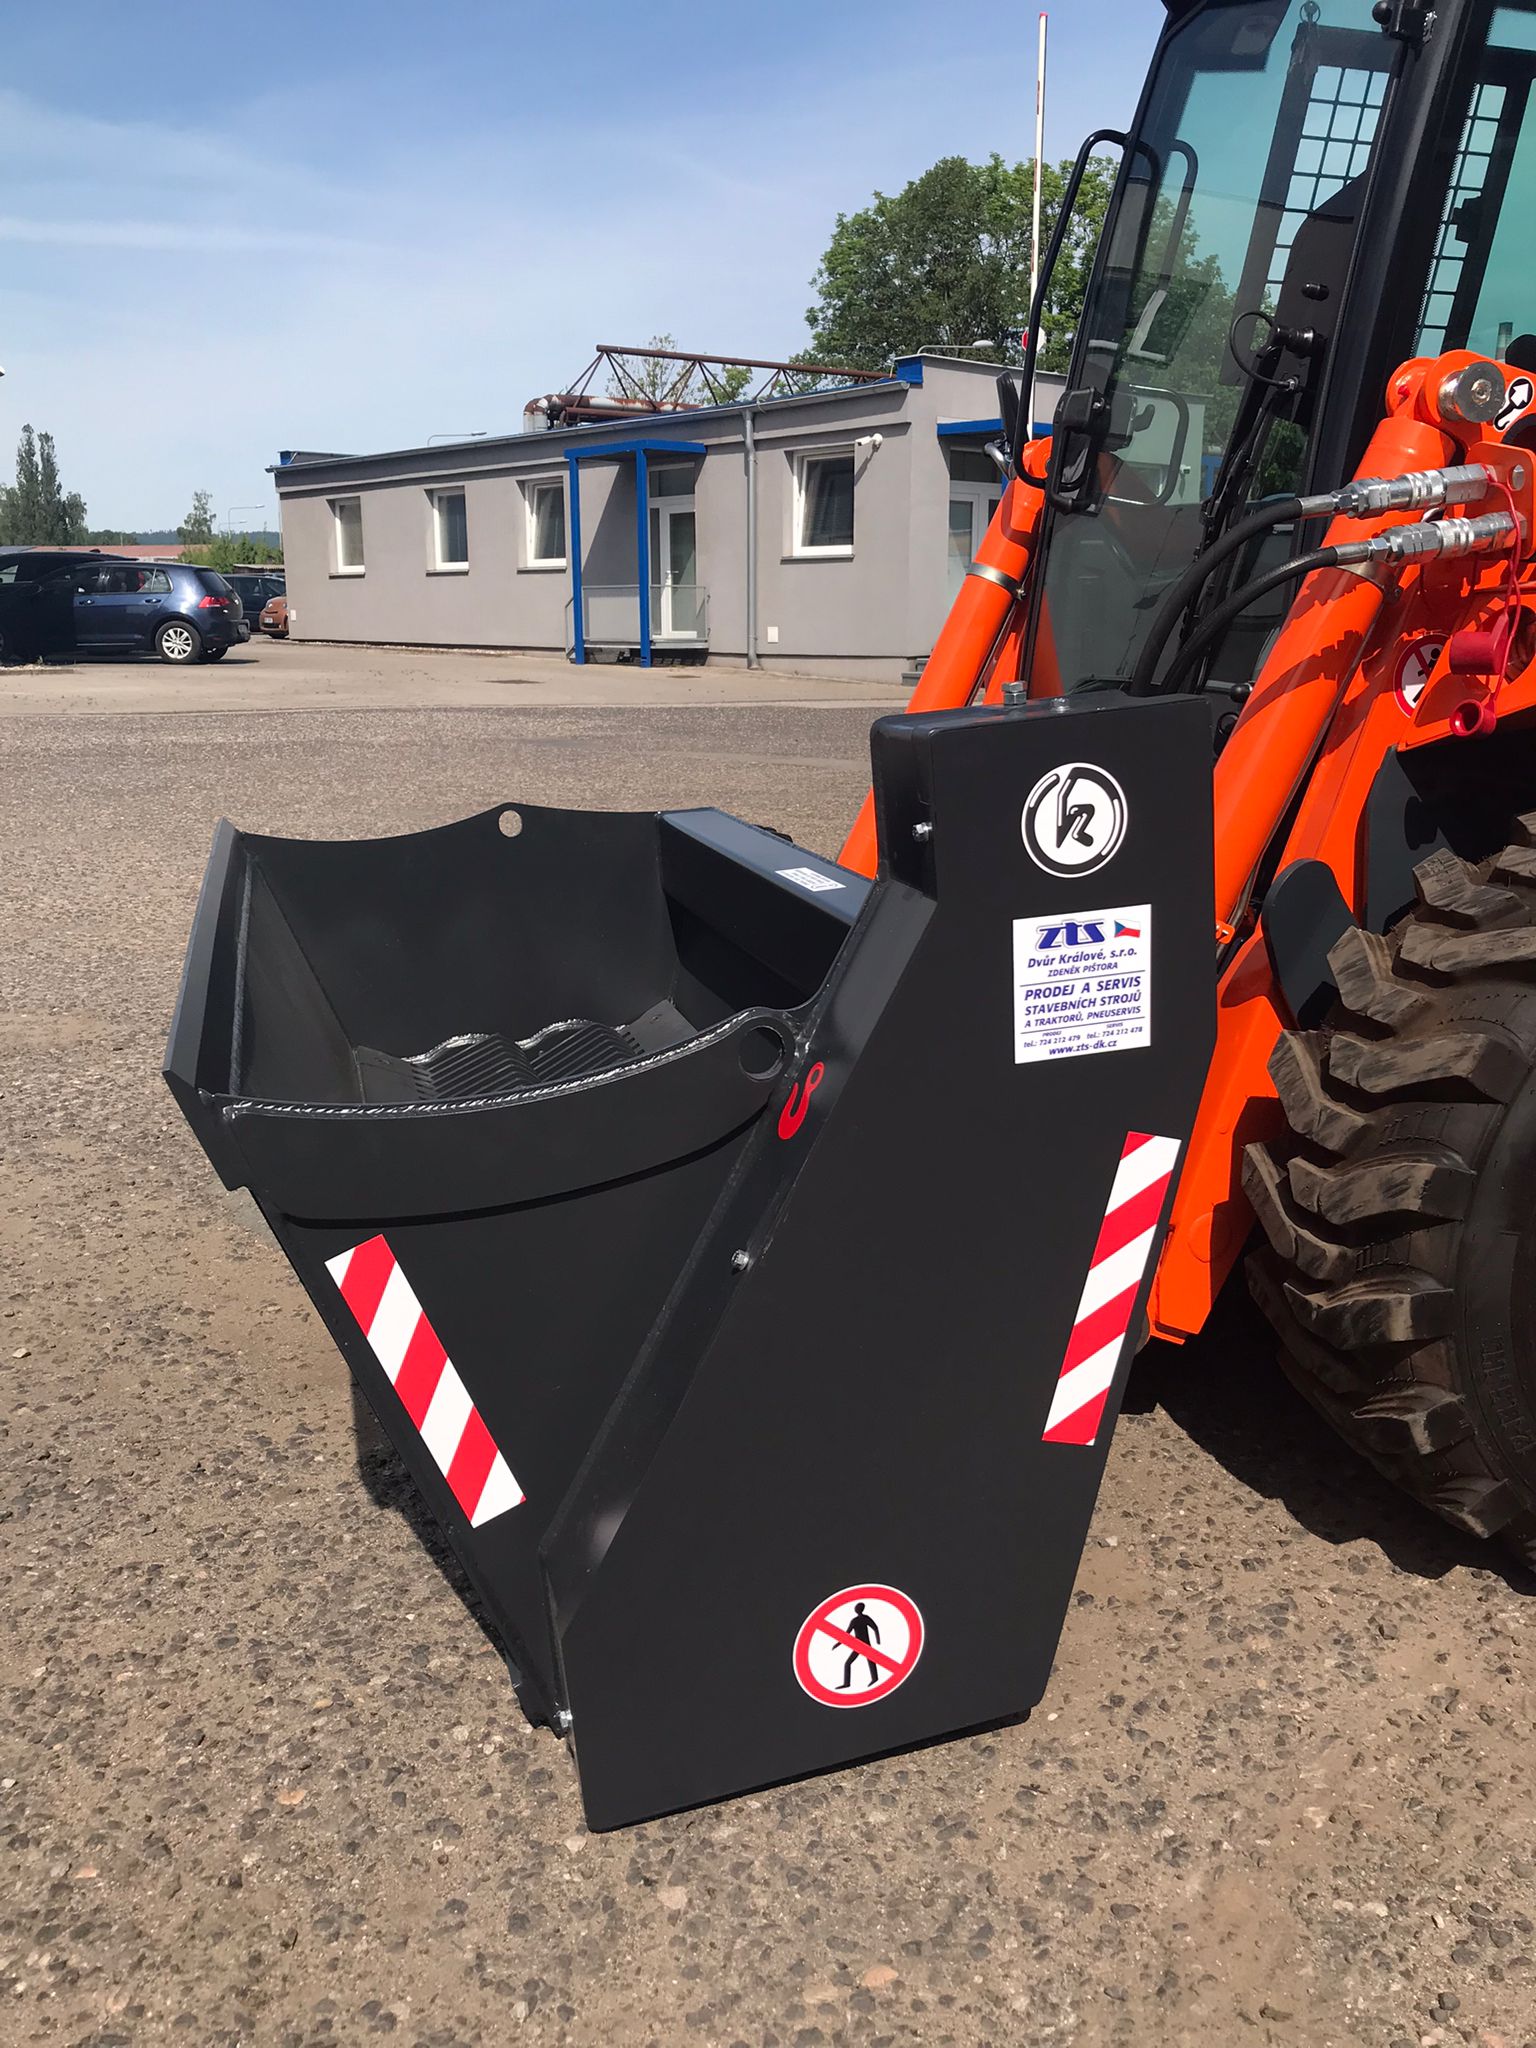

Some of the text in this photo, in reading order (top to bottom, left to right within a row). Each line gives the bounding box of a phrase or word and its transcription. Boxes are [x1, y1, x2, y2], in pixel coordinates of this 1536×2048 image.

[1027, 947, 1137, 969] Dvůr Králové, s.r.o.
[1047, 962, 1118, 978] ZDENĚK PIŠTORA
[1024, 976, 1141, 1001] PRODEJ A SERVIS
[1024, 989, 1142, 1016] STAVEBNÍCH STROJŮ
[1024, 1005, 1141, 1029] A TRAKTORŮ, PNEUSERVIS
[1039, 1038, 1052, 1046] 724
[1053, 1036, 1066, 1044] 212
[1068, 1034, 1081, 1042] 479
[1102, 1030, 1114, 1038] 724
[1116, 1028, 1128, 1036] 212
[1049, 1039, 1118, 1056] www.zts-dk.cz
